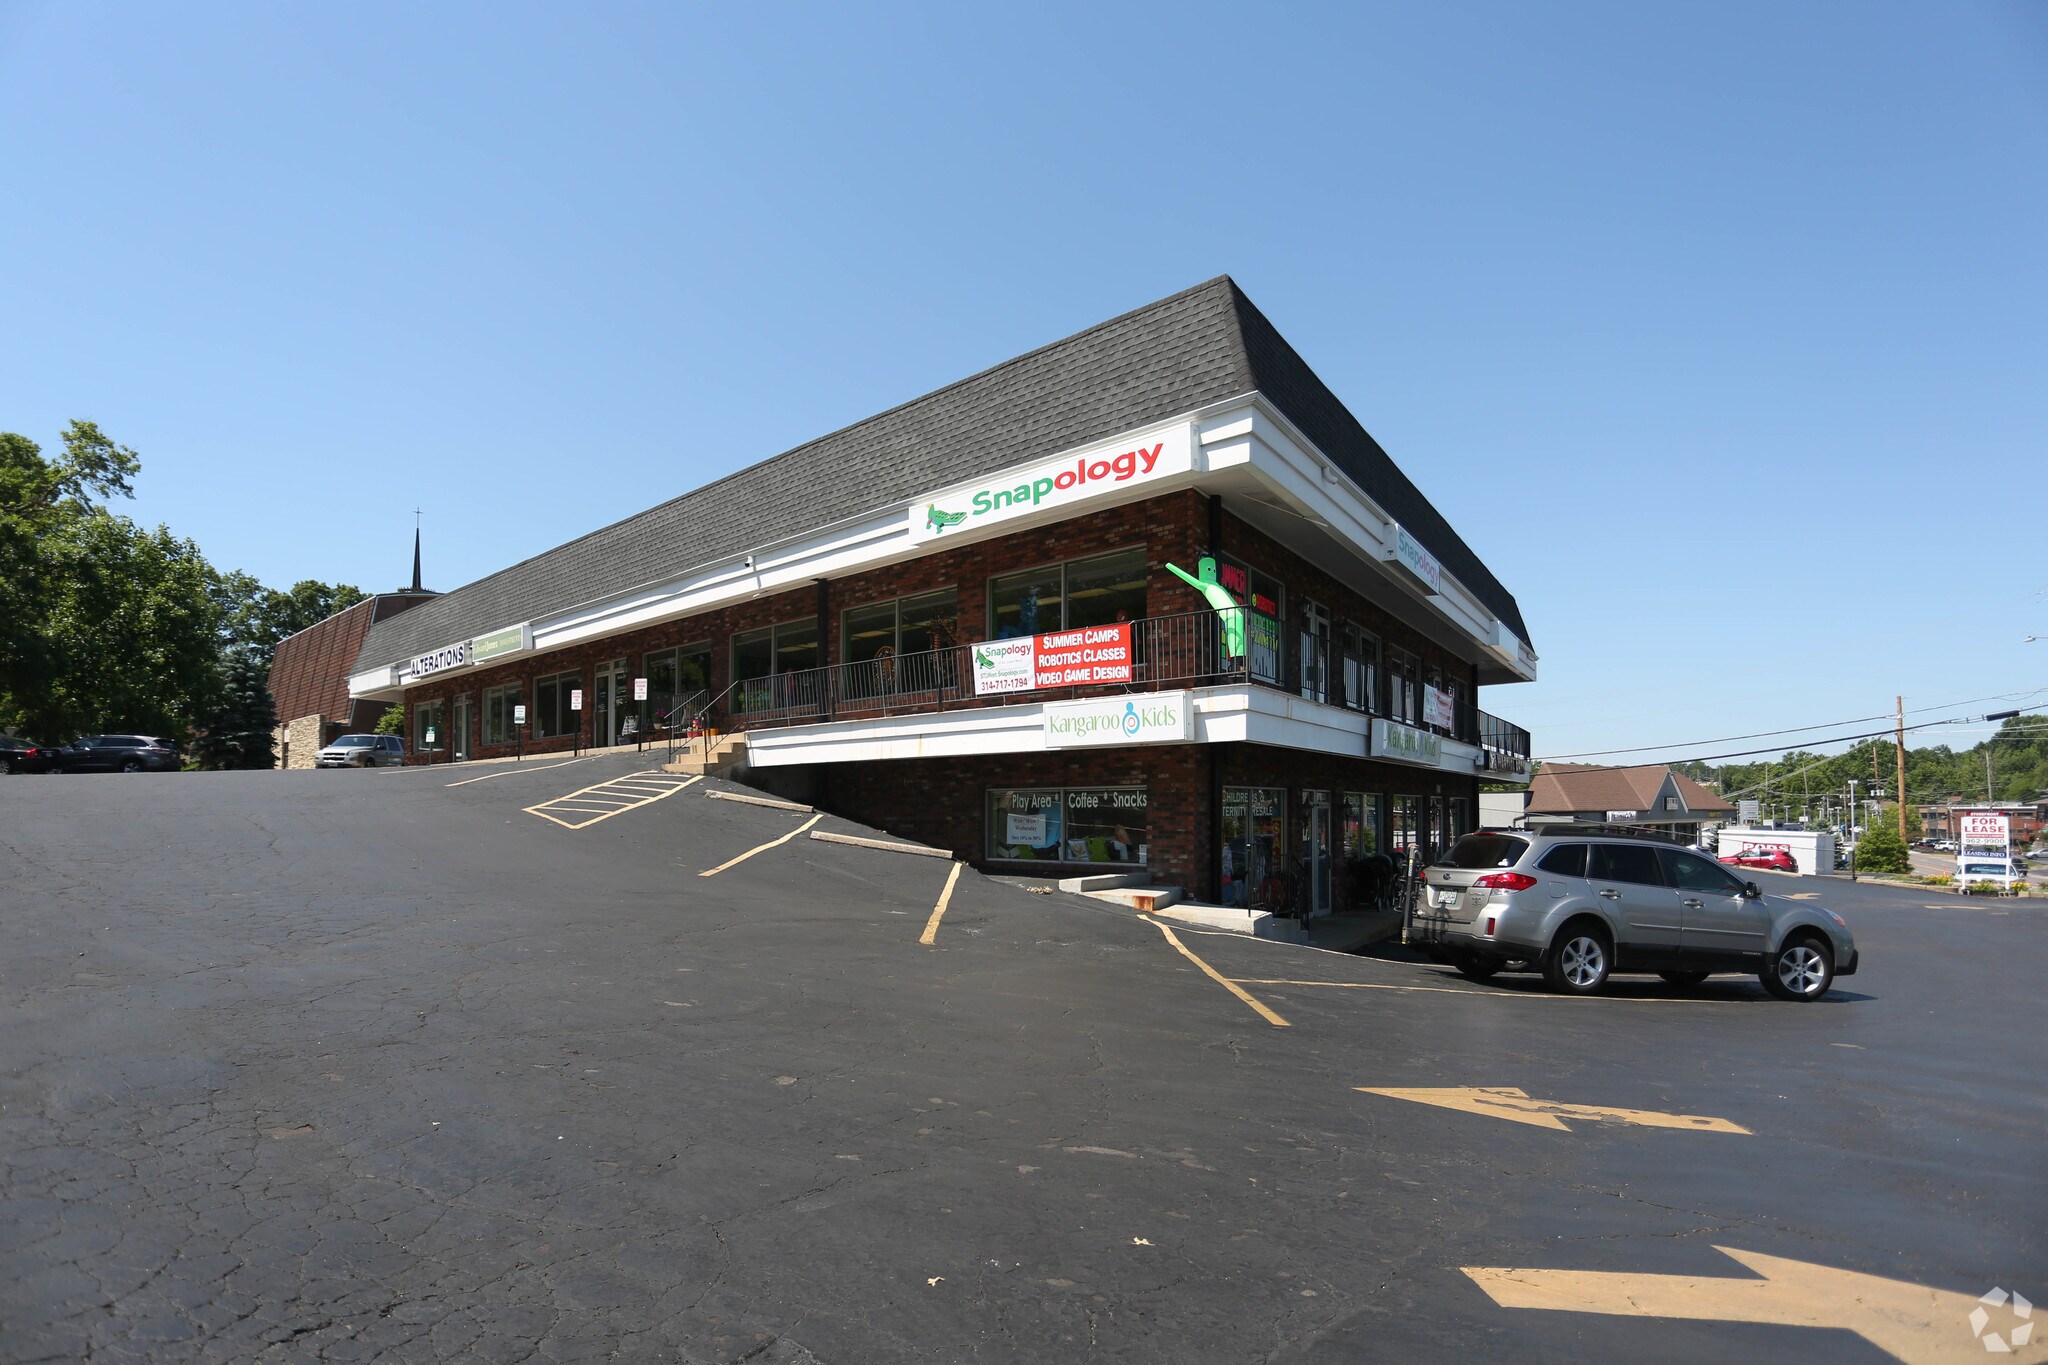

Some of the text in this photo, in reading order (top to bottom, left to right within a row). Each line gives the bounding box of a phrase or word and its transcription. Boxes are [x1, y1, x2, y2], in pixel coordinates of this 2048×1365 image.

[972, 442, 1163, 516] Snapology
[1399, 533, 1438, 587] Snapology
[1043, 629, 1120, 650] SUMMER CAMPS
[411, 646, 464, 676] ALTERATIONS
[985, 645, 1032, 658] Snapology
[1038, 647, 1126, 668] ROBOTICS CLASSES
[981, 678, 1028, 691] 314-717-1794
[1036, 666, 1130, 685] VIDEO GAME DESIGN
[1050, 705, 1176, 737] Kangaroo Kids
[1012, 794, 1029, 811] Play
[1031, 793, 1052, 808] Area
[1068, 792, 1098, 808] Coffee
[1112, 791, 1147, 808] Snacks
